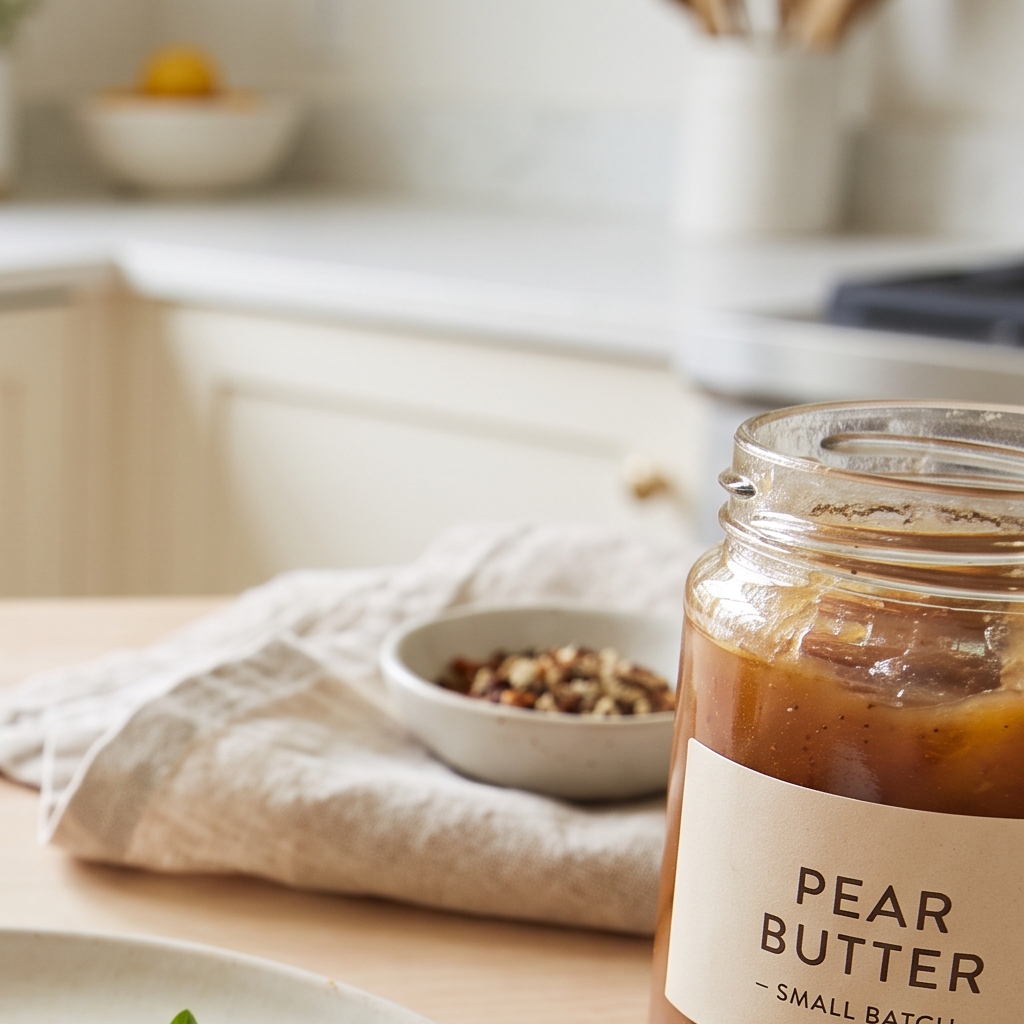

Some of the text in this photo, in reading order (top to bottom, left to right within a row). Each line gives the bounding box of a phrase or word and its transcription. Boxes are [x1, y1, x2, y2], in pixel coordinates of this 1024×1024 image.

[796, 866, 953, 934] PEAR
[760, 912, 985, 995] BUTTER
[776, 983, 856, 1021] SMALL
